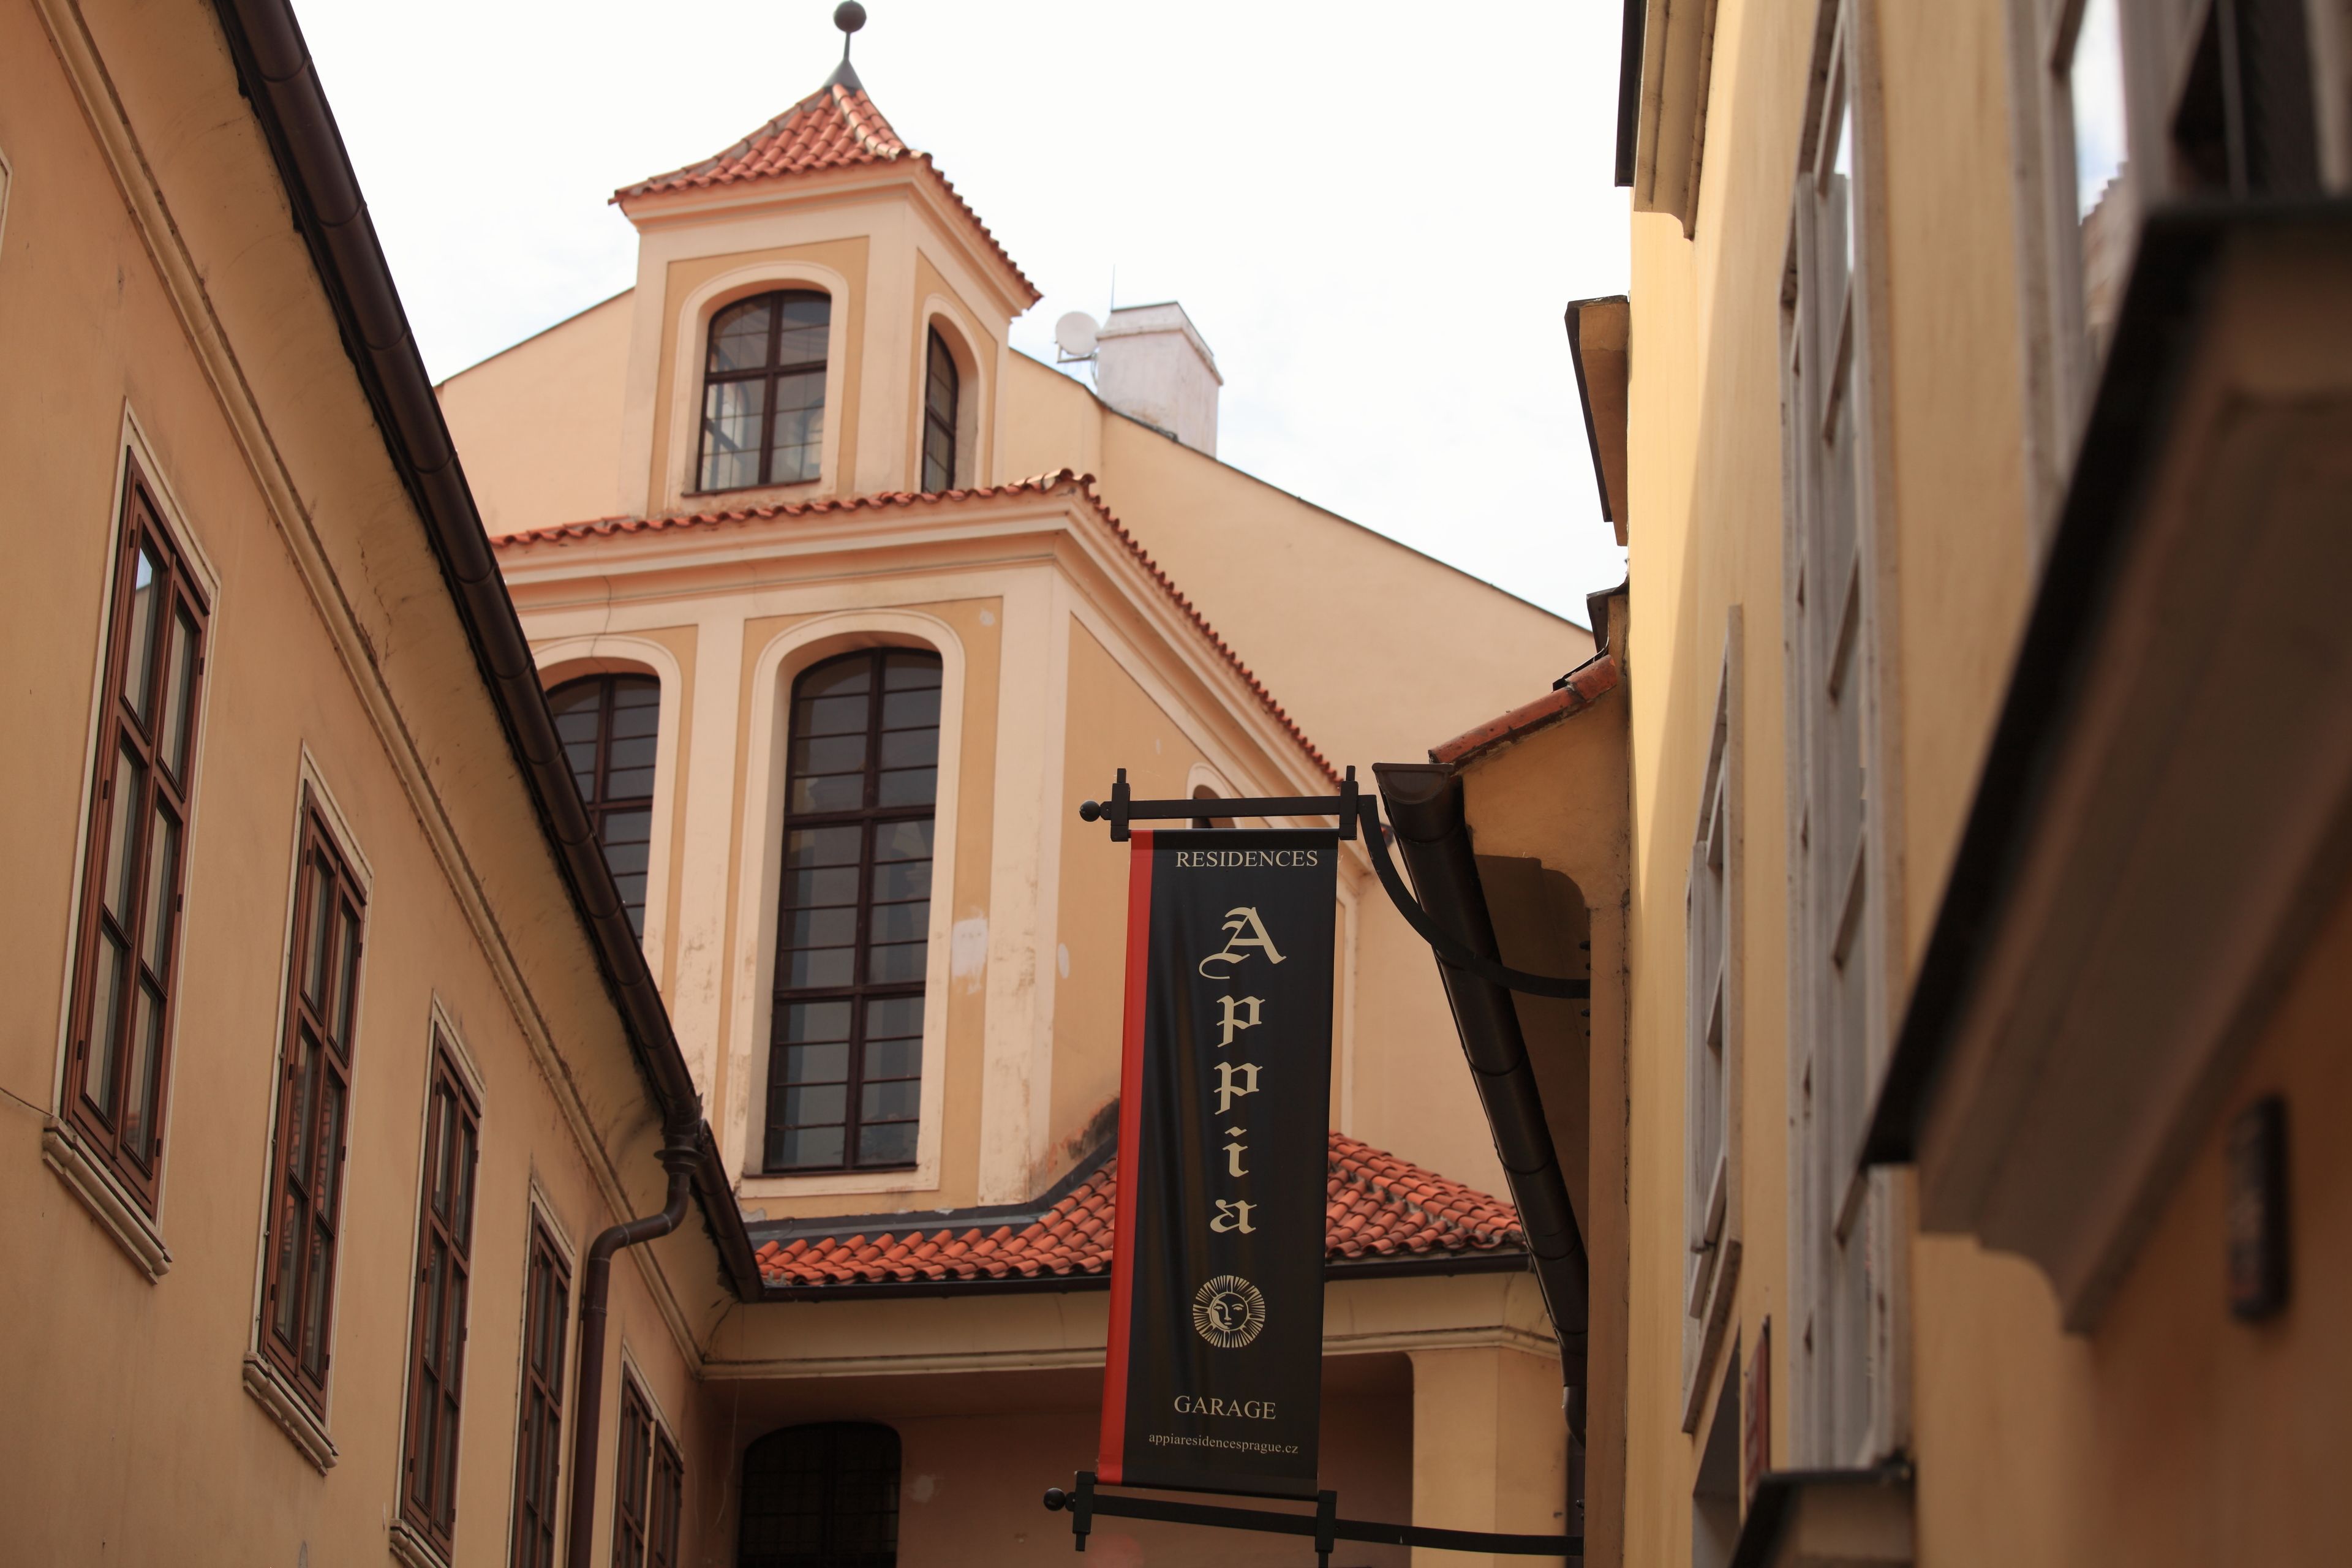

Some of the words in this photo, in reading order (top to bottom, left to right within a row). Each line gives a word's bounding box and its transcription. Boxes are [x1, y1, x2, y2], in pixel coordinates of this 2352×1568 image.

[1175, 850, 1318, 867] RESIDENCES
[1199, 907, 1286, 1234] Appia
[1174, 1395, 1276, 1419] GARAGE
[1148, 1433, 1298, 1454] appiaresidencesprague.cz
